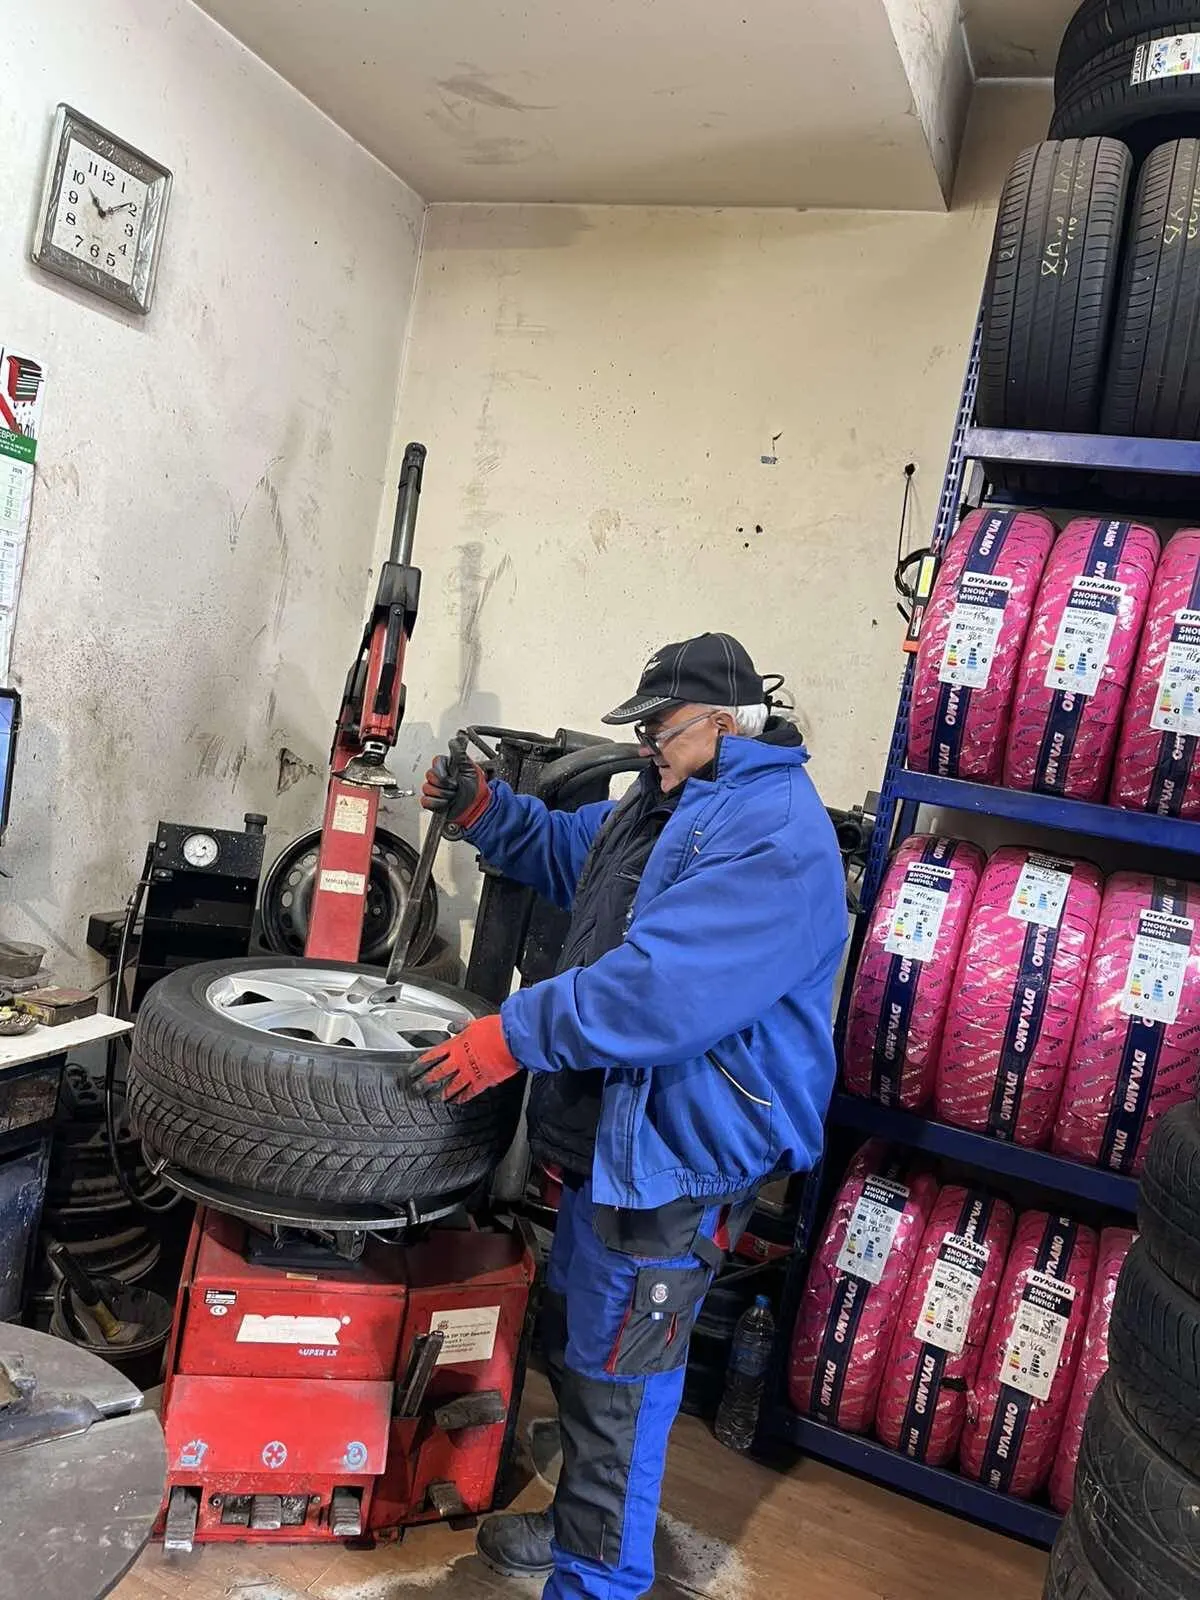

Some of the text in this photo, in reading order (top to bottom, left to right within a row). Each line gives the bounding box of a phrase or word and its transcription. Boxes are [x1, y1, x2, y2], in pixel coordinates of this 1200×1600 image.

[88, 161, 98, 176] 11
[72, 169, 85, 185] 10
[102, 169, 115, 186] 12
[68, 190, 78, 204] 9
[129, 202, 138, 217] 2
[66, 212, 76, 225] 8
[124, 223, 133, 237] 3
[74, 235, 84, 248] 7
[90, 244, 100, 257] 6
[118, 243, 127, 256] 4
[106, 253, 116, 267] 5
[967, 576, 1009, 587] DYNAMO
[1078, 580, 1122, 592] DYNAMO
[960, 594, 989, 603] MWH01
[962, 587, 995, 597] SNOW-H
[1073, 591, 1107, 602] SNOW-H
[1071, 598, 1100, 608] MWH01
[1178, 633, 1200, 644] MWH
[1044, 731, 1065, 785] DYNAMO
[909, 872, 939, 882] SNOW-H
[913, 864, 951, 876] DYNAMO
[1145, 912, 1189, 926] DYNAMO
[1140, 927, 1171, 939] MWH01
[1142, 920, 1176, 933] SNOW-H
[1014, 987, 1036, 1053] DYNAMO
[885, 1002, 902, 1060] DYNAMO
[1123, 1048, 1147, 1113] DYNAMO
[1000, 1071, 1018, 1121] DYNAMO
[866, 1185, 894, 1199] SNOW-H
[871, 1177, 907, 1193] DYNAMO
[864, 1190, 889, 1204] MWH01
[949, 1236, 985, 1257] DYNAMO
[946, 1247, 976, 1263] SNOW-H
[1032, 1275, 1071, 1295] DYNAMO
[1028, 1294, 1055, 1310] MWH01
[1030, 1287, 1061, 1305] SNOW-H
[834, 1280, 858, 1343] DYNAMO
[821, 1360, 837, 1406] DYNAMO
[915, 1354, 936, 1414] DYNAMO
[996, 1402, 1018, 1459] DYNAMO
